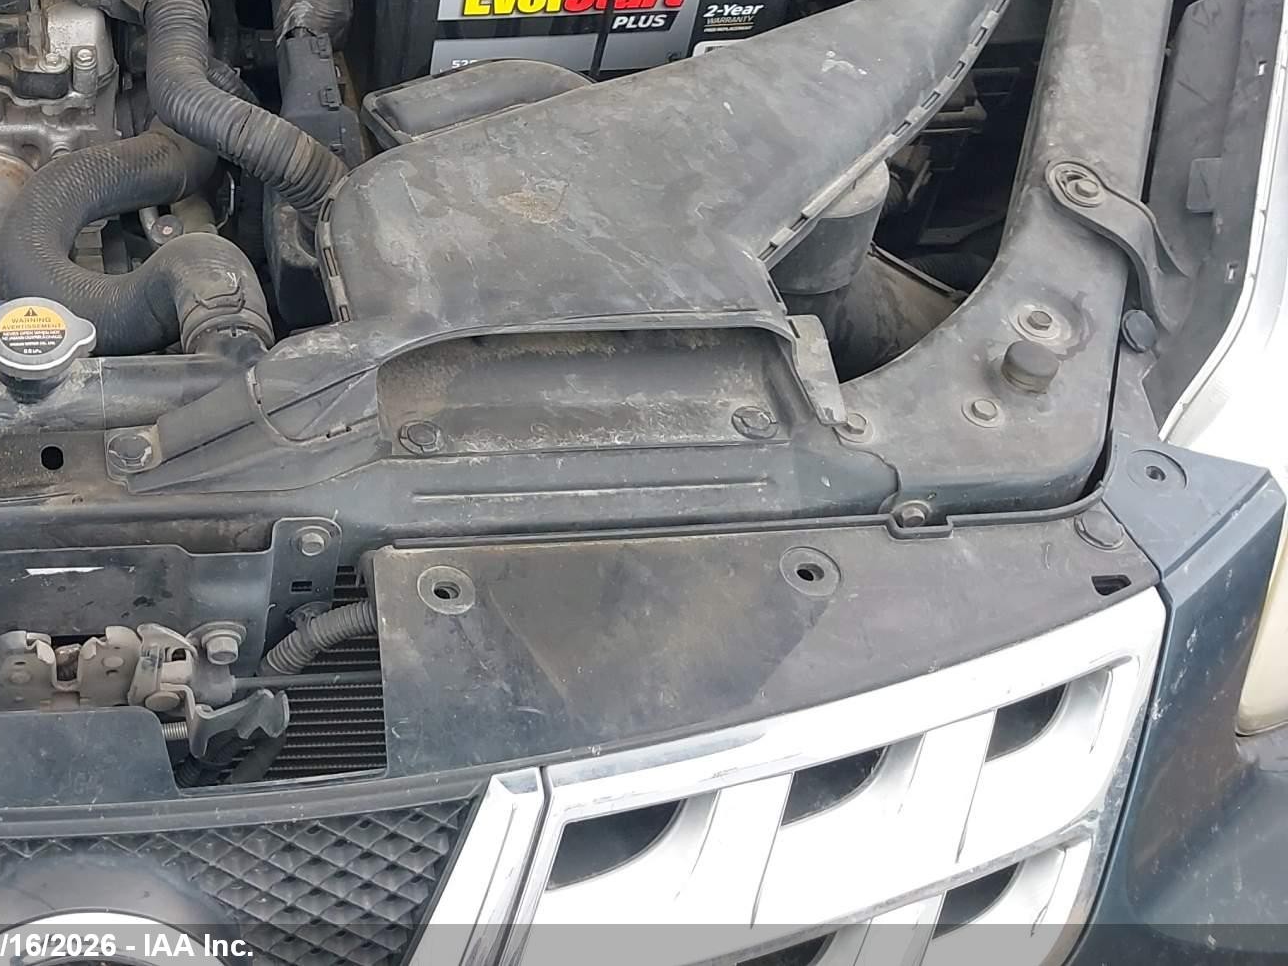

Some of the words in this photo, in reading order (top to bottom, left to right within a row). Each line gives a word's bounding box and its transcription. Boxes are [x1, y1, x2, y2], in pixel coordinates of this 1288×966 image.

[703, 3, 764, 18] 2-Year
[612, 14, 668, 31] PLUS
[706, 15, 754, 25] WARRANTY
